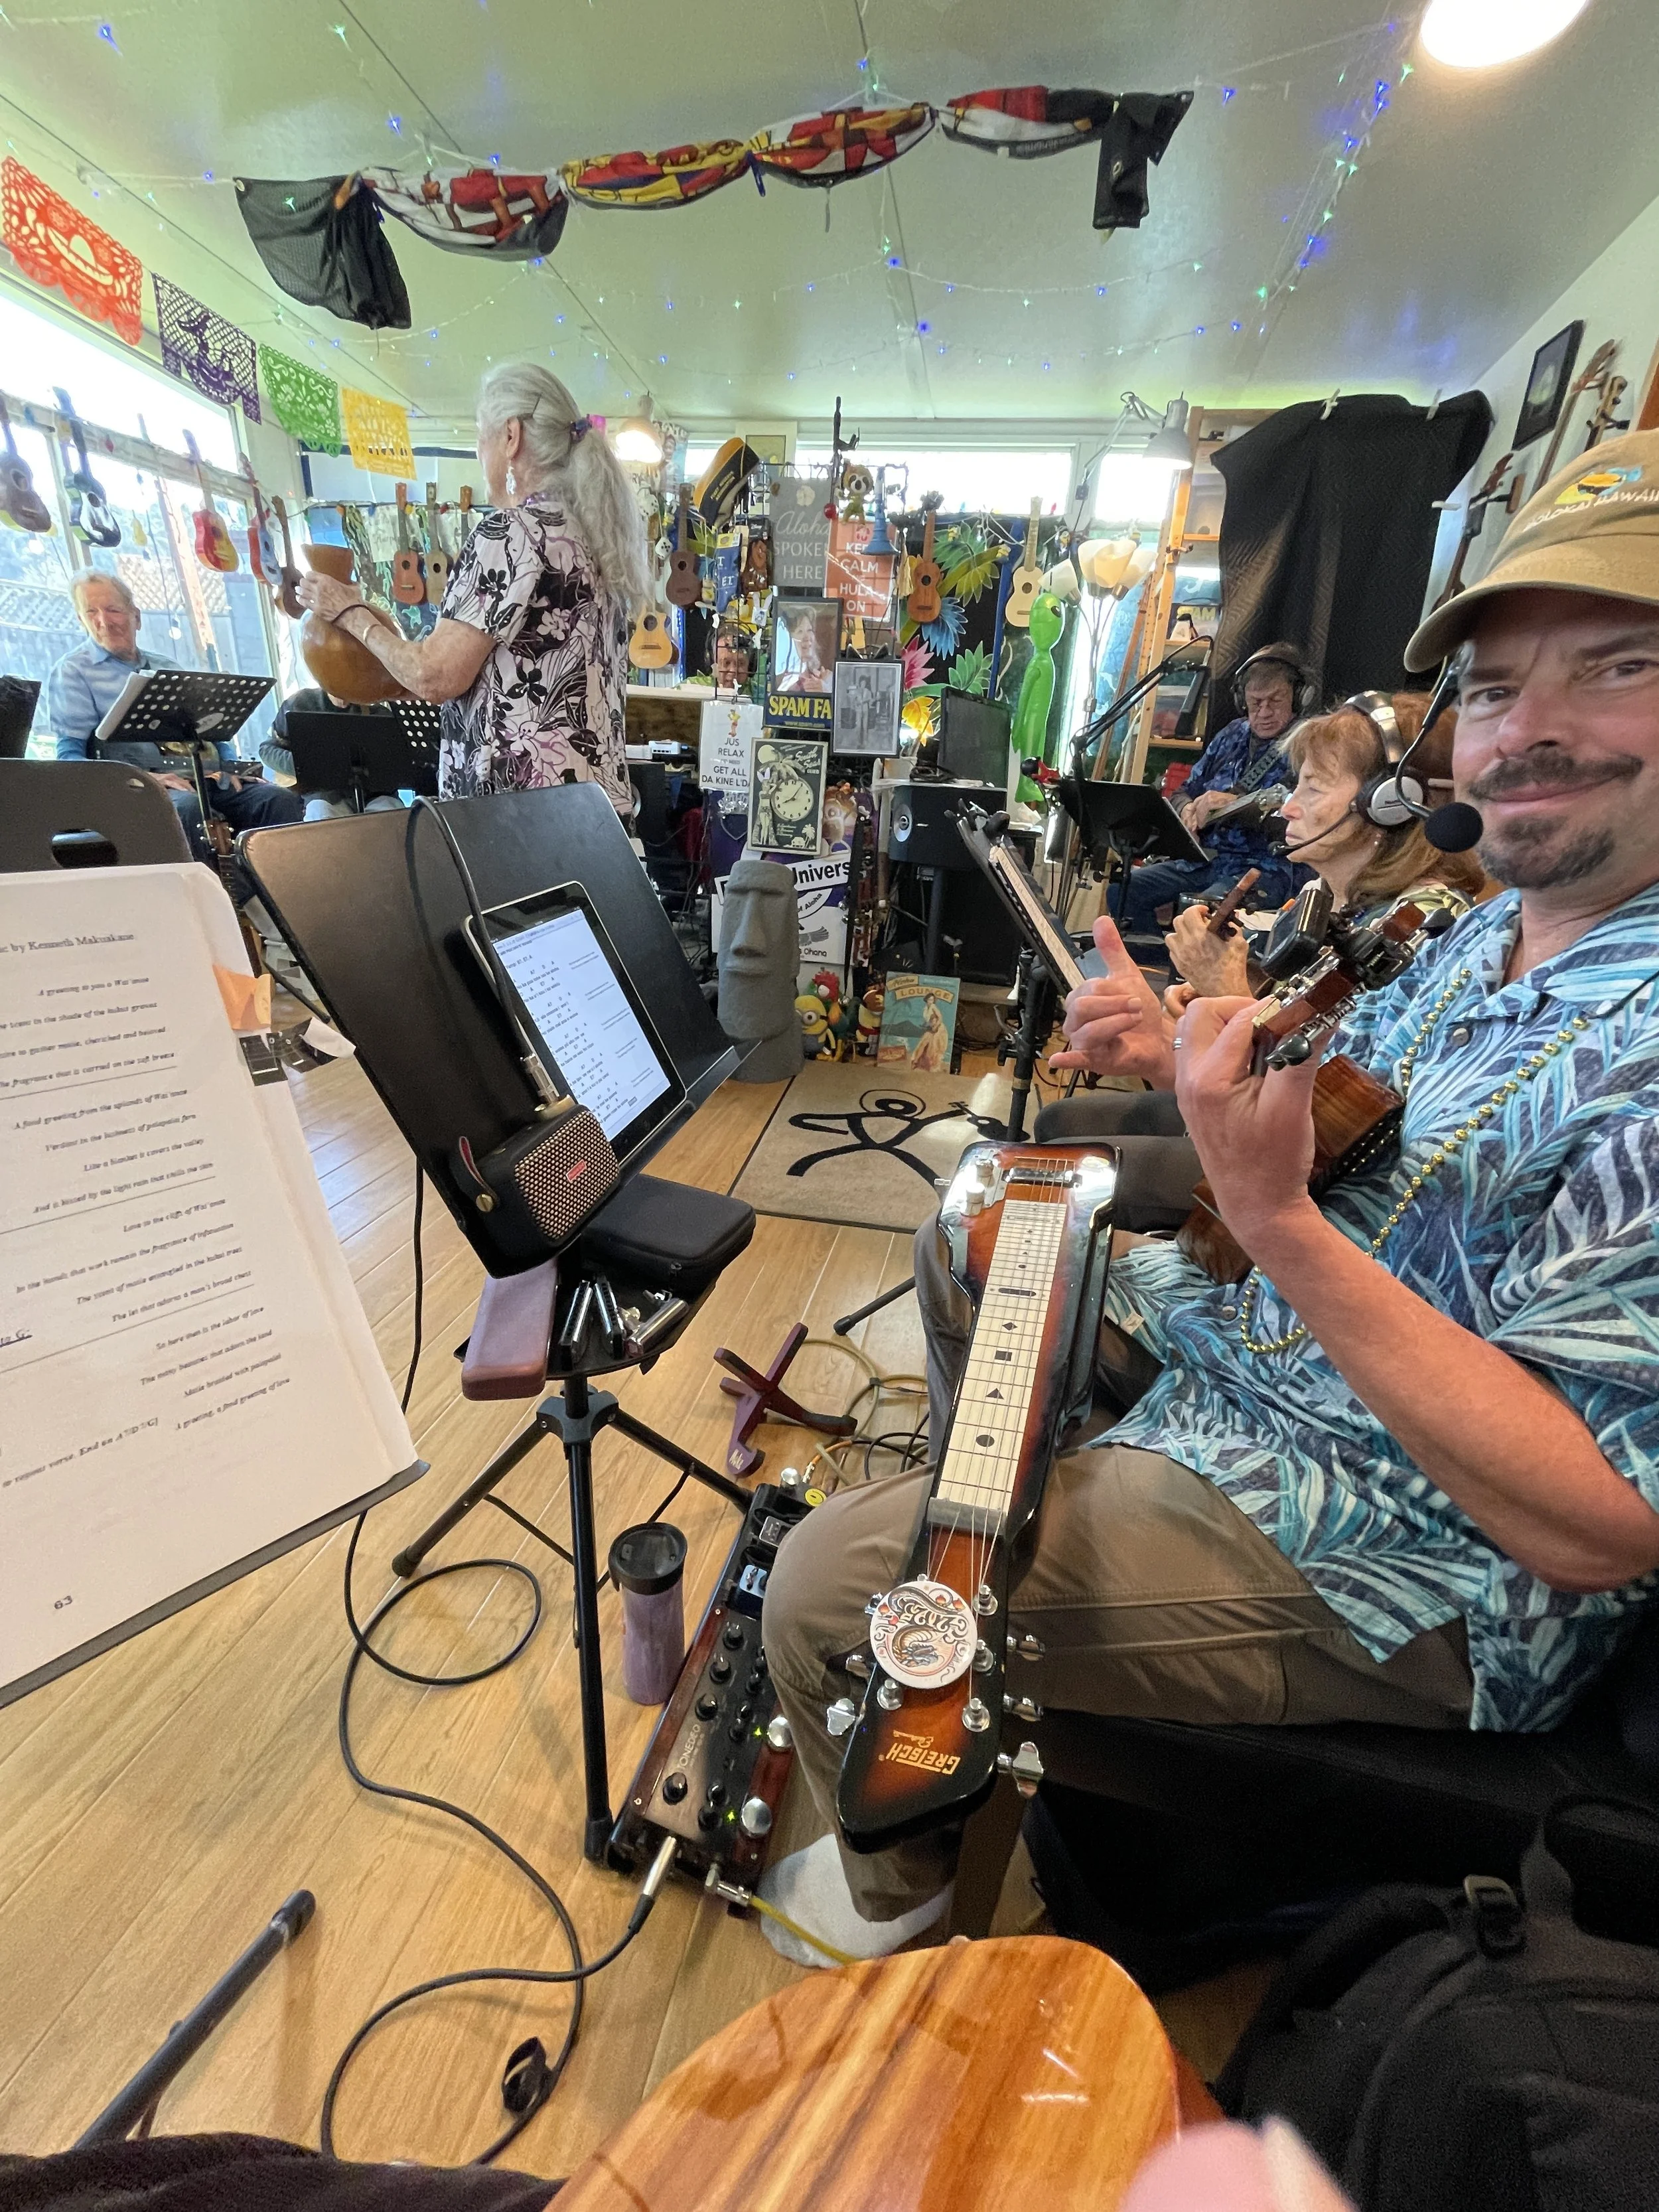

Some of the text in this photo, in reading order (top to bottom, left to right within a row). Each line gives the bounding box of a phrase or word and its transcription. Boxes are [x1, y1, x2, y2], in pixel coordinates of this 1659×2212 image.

[776, 511, 830, 535] Aloha
[774, 542, 828, 557] SPOKE
[783, 565, 823, 579] HERE
[839, 559, 878, 573] CALM
[846, 601, 865, 613] ON
[769, 696, 833, 719] SPAM FA
[725, 737, 739, 747] JUS
[717, 747, 745, 758] RELAX
[713, 765, 747, 776] GET ALL
[701, 774, 713, 783] DA
[715, 776, 733, 788] KINE
[804, 948, 828, 957] Ohana
[54, 1595, 73, 1610] 63
[886, 1743, 960, 1775] GRETSCH
